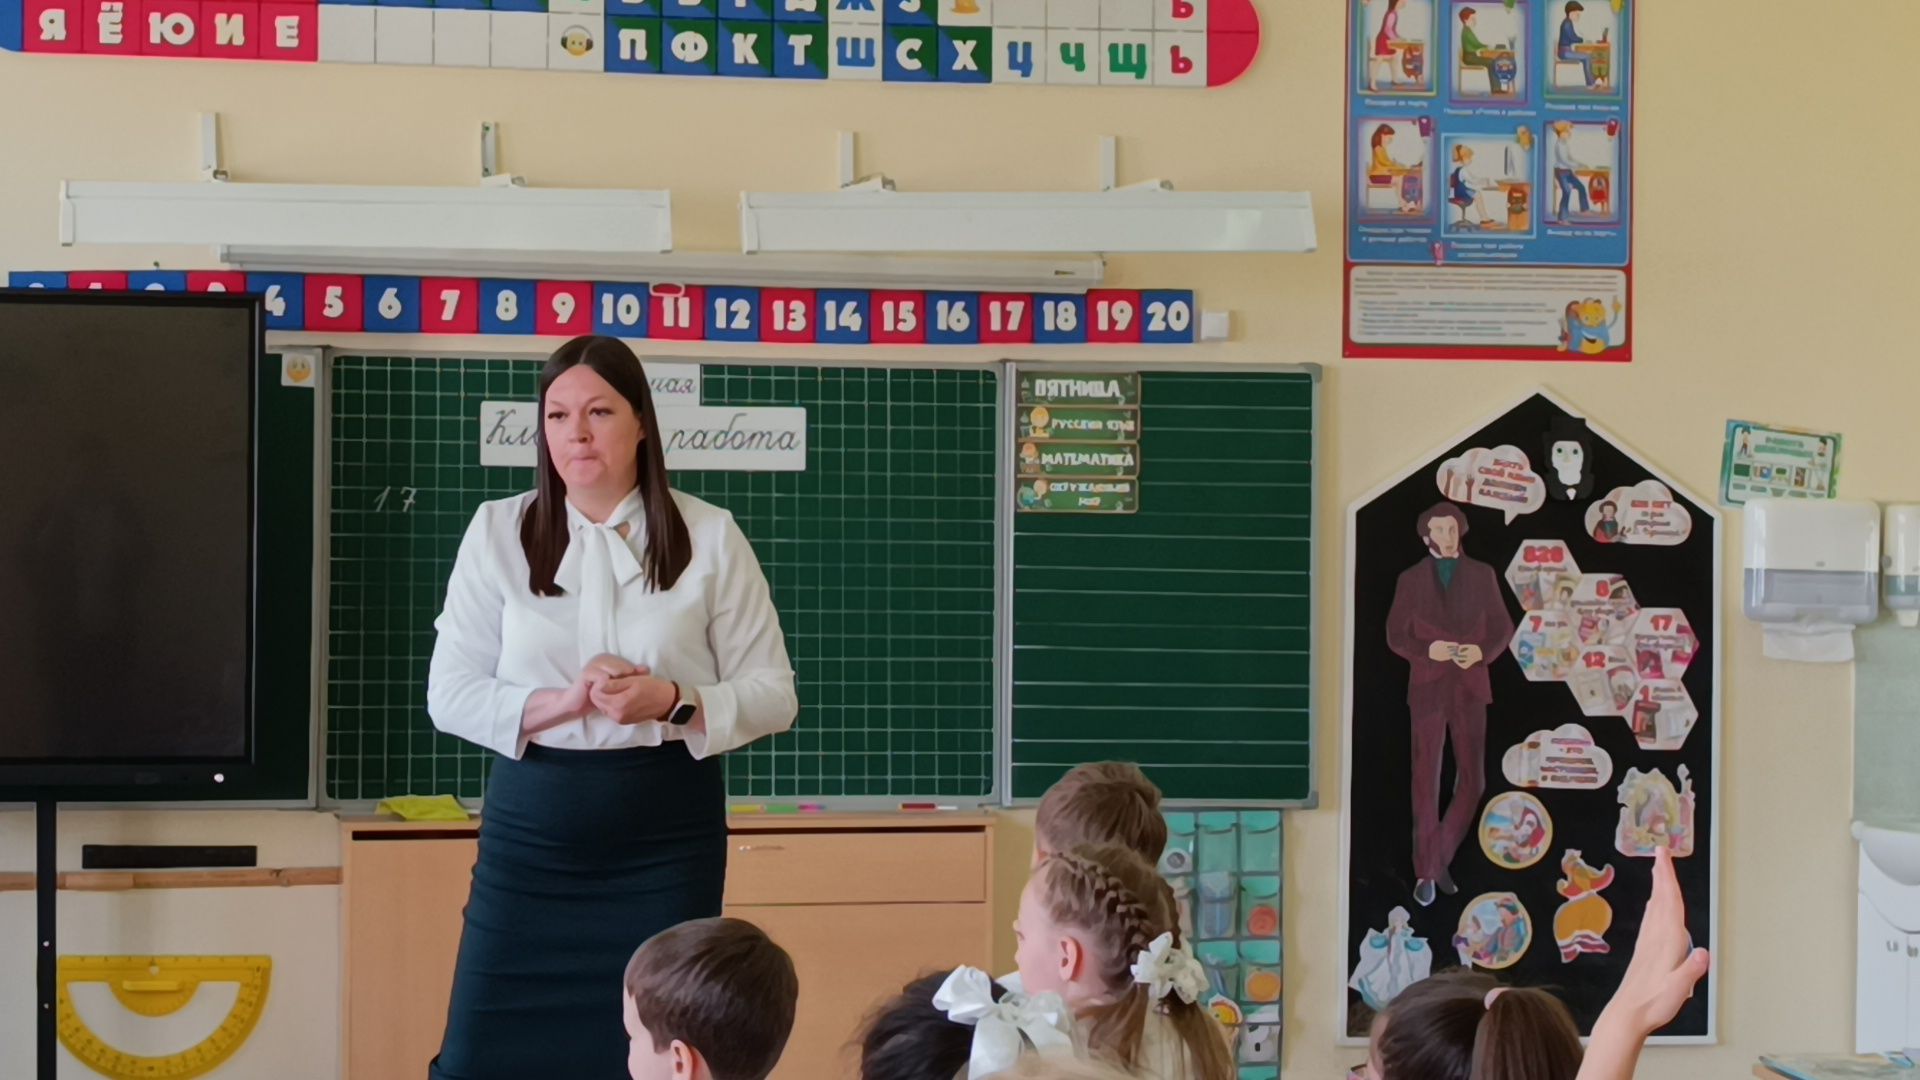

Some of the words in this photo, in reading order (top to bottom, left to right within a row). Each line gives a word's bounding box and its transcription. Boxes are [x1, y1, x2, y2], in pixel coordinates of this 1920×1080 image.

[38, 8, 67, 41] Я
[97, 2, 124, 44] Ё
[148, 11, 195, 45] Ю
[214, 13, 245, 46] И
[274, 15, 300, 48] Е
[618, 28, 648, 61] П
[671, 31, 708, 63] Ф
[732, 33, 760, 65] К
[788, 34, 813, 66] Т
[836, 36, 876, 67] Ш
[896, 38, 923, 70] С
[951, 39, 979, 71] Х
[1007, 41, 1034, 78] Ц
[1059, 42, 1086, 72] Ч
[1107, 43, 1148, 80] Щ
[265, 285, 286, 316] 4
[322, 285, 344, 318] 5
[378, 287, 402, 319] 6
[439, 289, 461, 321] 7
[495, 289, 518, 321] 8
[551, 292, 576, 324] 9
[601, 293, 640, 325] 10
[662, 295, 690, 328] 11
[714, 298, 750, 329] 12
[772, 300, 807, 331] 13
[824, 300, 862, 331] 14
[882, 300, 917, 332] 15
[936, 300, 970, 332] 16
[989, 300, 1025, 331] 17
[1043, 301, 1077, 332] 18
[1096, 300, 1133, 331] 19
[1146, 300, 1190, 331] 20
[1034, 378, 1121, 398] ПЯТНИЦА
[666, 412, 802, 455] работа
[1041, 452, 1135, 467] МАТЕМАТИКА
